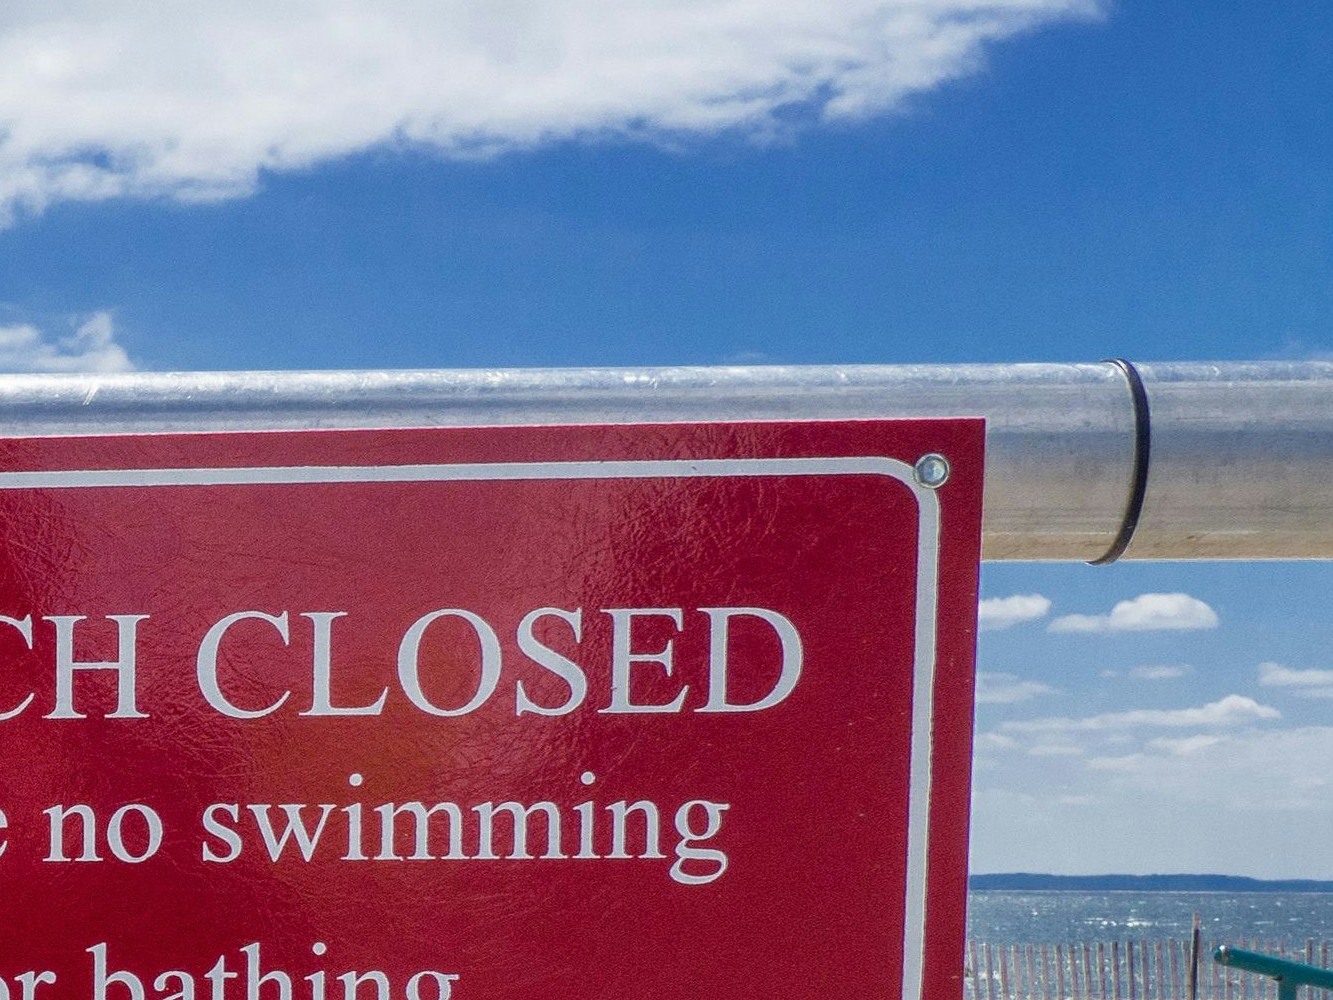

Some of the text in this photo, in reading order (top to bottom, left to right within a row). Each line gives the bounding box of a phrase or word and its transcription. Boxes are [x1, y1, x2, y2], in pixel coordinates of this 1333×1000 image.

[196, 606, 804, 719] CLOSED
[42, 803, 164, 863] no
[202, 771, 730, 885] swimming
